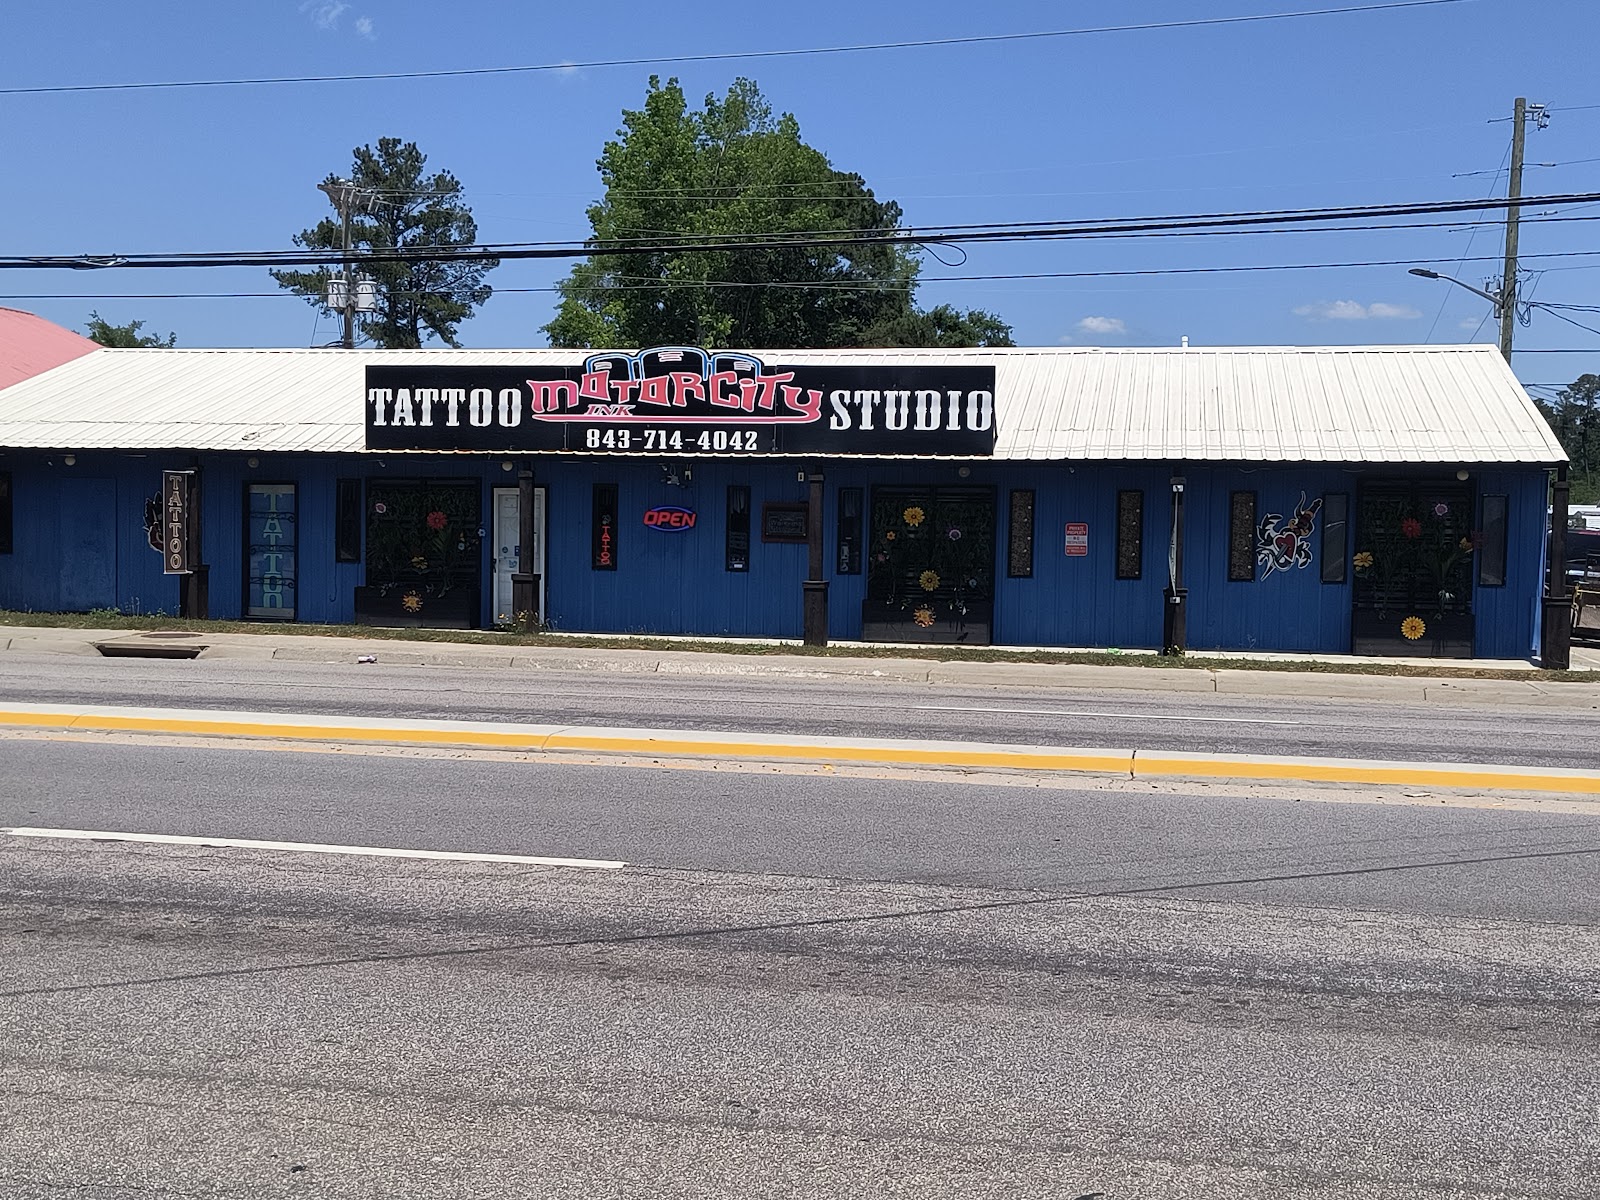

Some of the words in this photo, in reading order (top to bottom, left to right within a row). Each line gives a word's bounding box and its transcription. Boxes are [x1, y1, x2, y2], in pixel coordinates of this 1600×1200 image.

[368, 388, 522, 427] TATTOO
[829, 390, 993, 431] STUDIO
[582, 404, 636, 416] INK
[586, 428, 758, 450] 843-714-4042
[168, 475, 183, 569] TATTOO
[643, 510, 697, 528] OPEN
[263, 492, 283, 608] TATTOO
[601, 526, 611, 565] TATTOO
